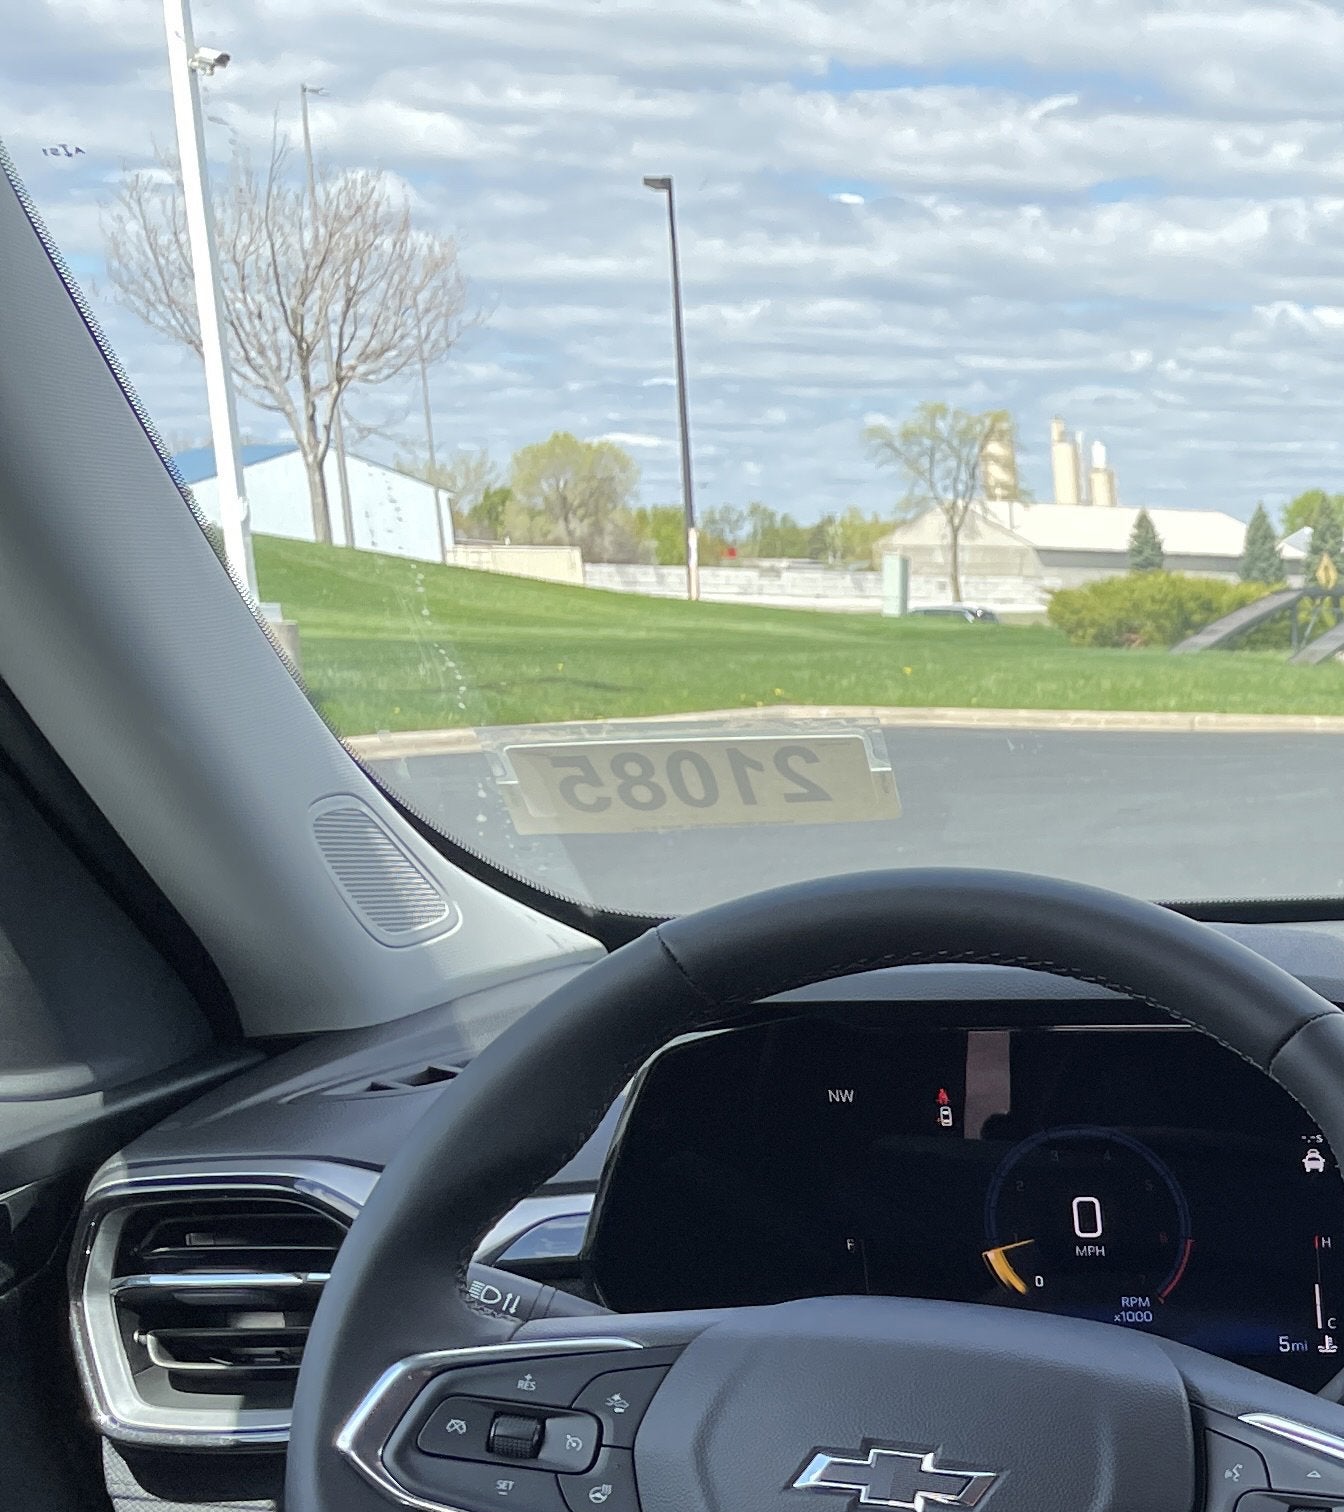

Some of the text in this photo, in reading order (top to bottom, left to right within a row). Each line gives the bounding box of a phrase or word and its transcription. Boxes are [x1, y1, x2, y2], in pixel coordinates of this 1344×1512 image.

[827, 1089, 854, 1103] NW
[1073, 1197, 1102, 1237] 0
[1321, 1236, 1331, 1248] H
[1075, 1245, 1106, 1257] MPH
[1121, 1296, 1151, 1308] RPM
[1327, 1317, 1337, 1330] C
[517, 1381, 536, 1391] RES
[495, 1479, 515, 1491] SET
